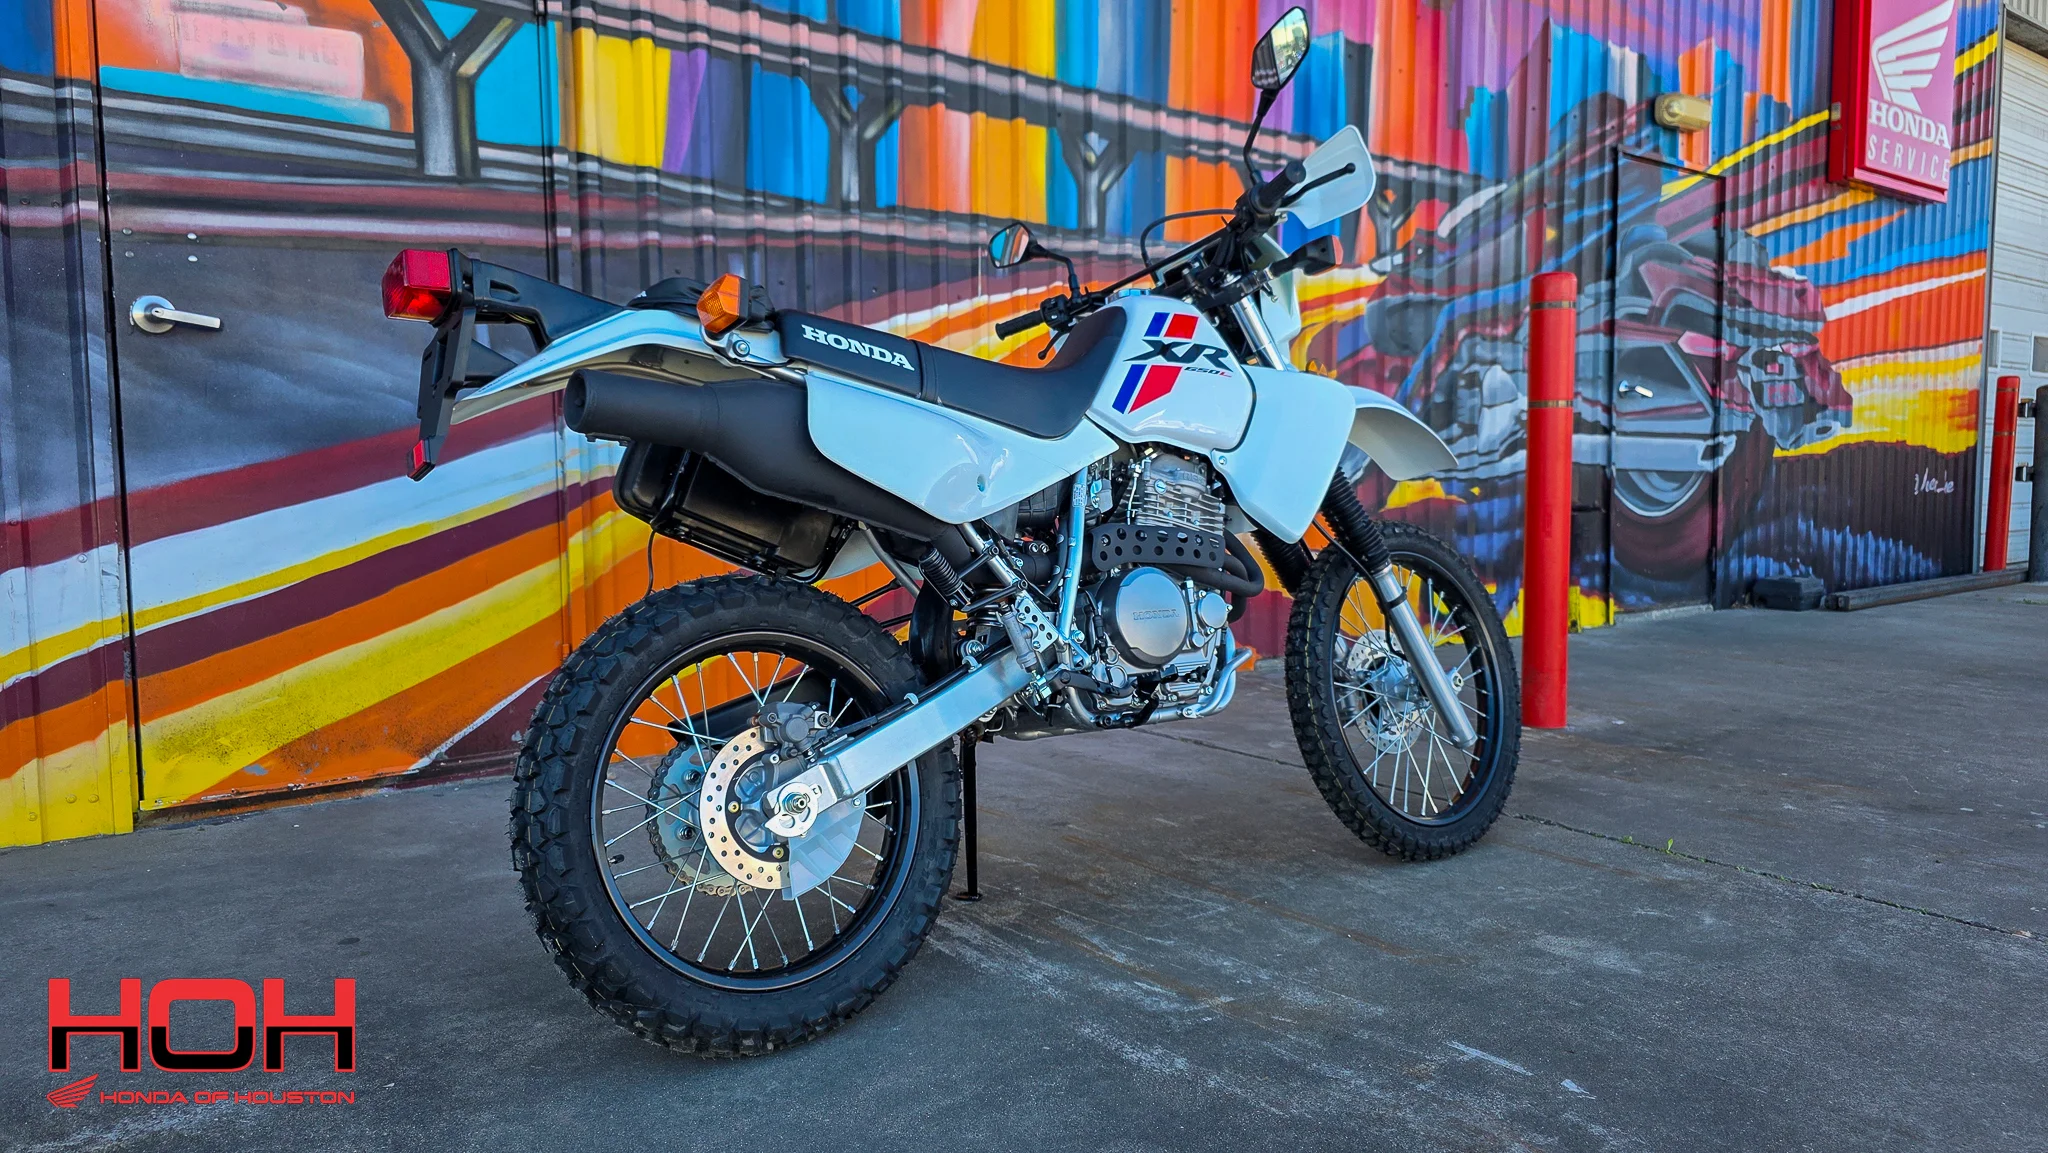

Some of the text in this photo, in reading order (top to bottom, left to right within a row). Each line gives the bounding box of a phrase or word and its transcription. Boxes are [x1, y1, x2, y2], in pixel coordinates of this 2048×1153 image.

[1869, 100, 1951, 149] HONDA
[1868, 134, 1950, 182] SERVICE
[801, 324, 915, 371] HONDA
[1123, 339, 1233, 373] XR
[1132, 608, 1180, 621] HONDA
